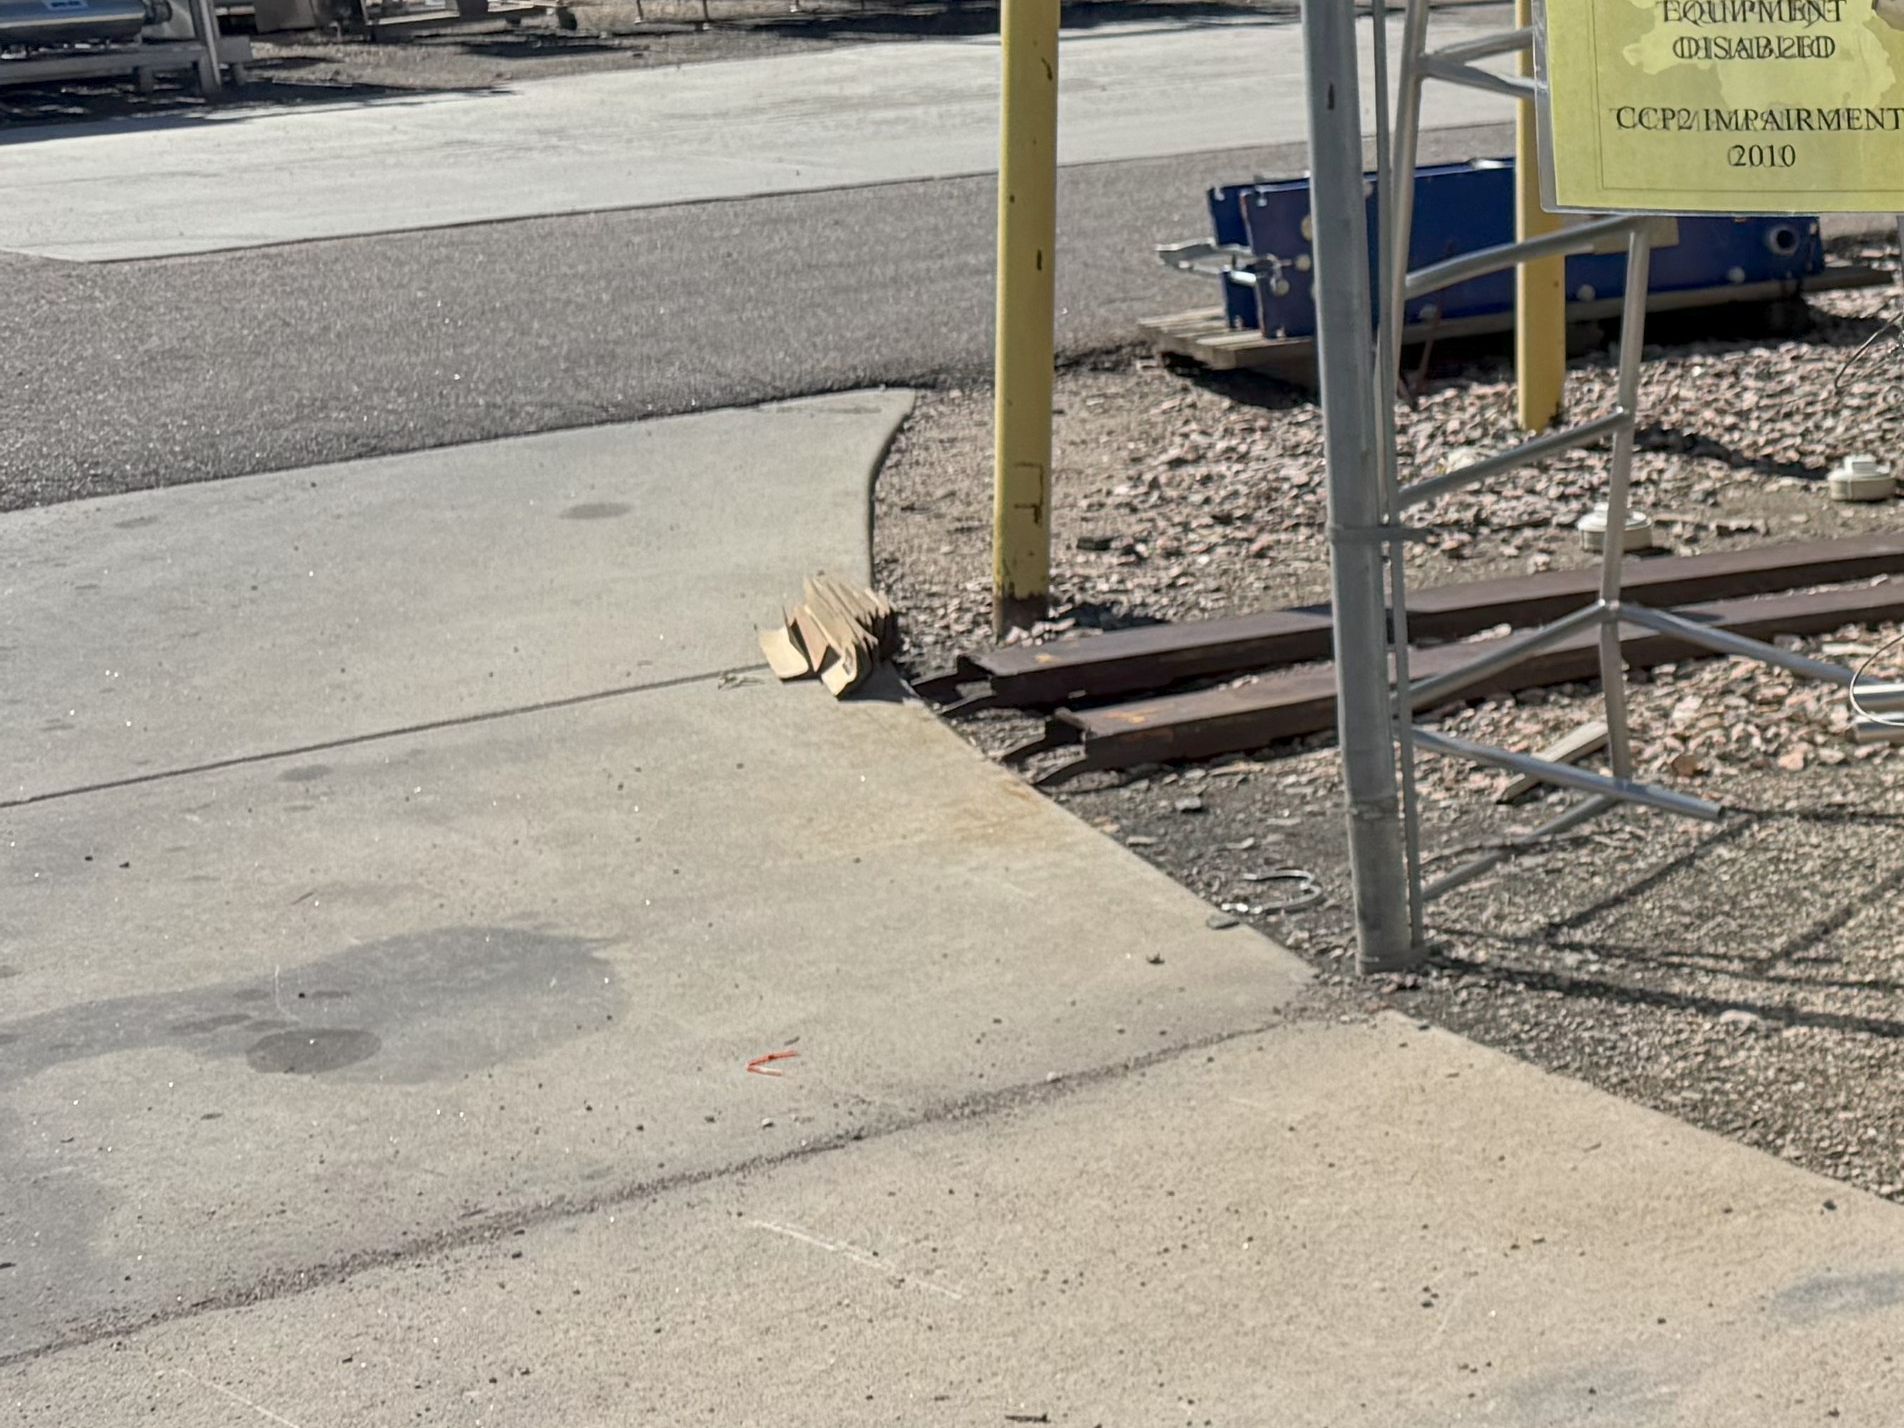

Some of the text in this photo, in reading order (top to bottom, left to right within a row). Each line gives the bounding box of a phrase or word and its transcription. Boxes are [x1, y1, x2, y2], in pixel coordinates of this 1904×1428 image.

[1675, 35, 1835, 60] DISABLED
[1702, 107, 1904, 132] IMPAIRMENT
[1731, 144, 1796, 167] 2010
